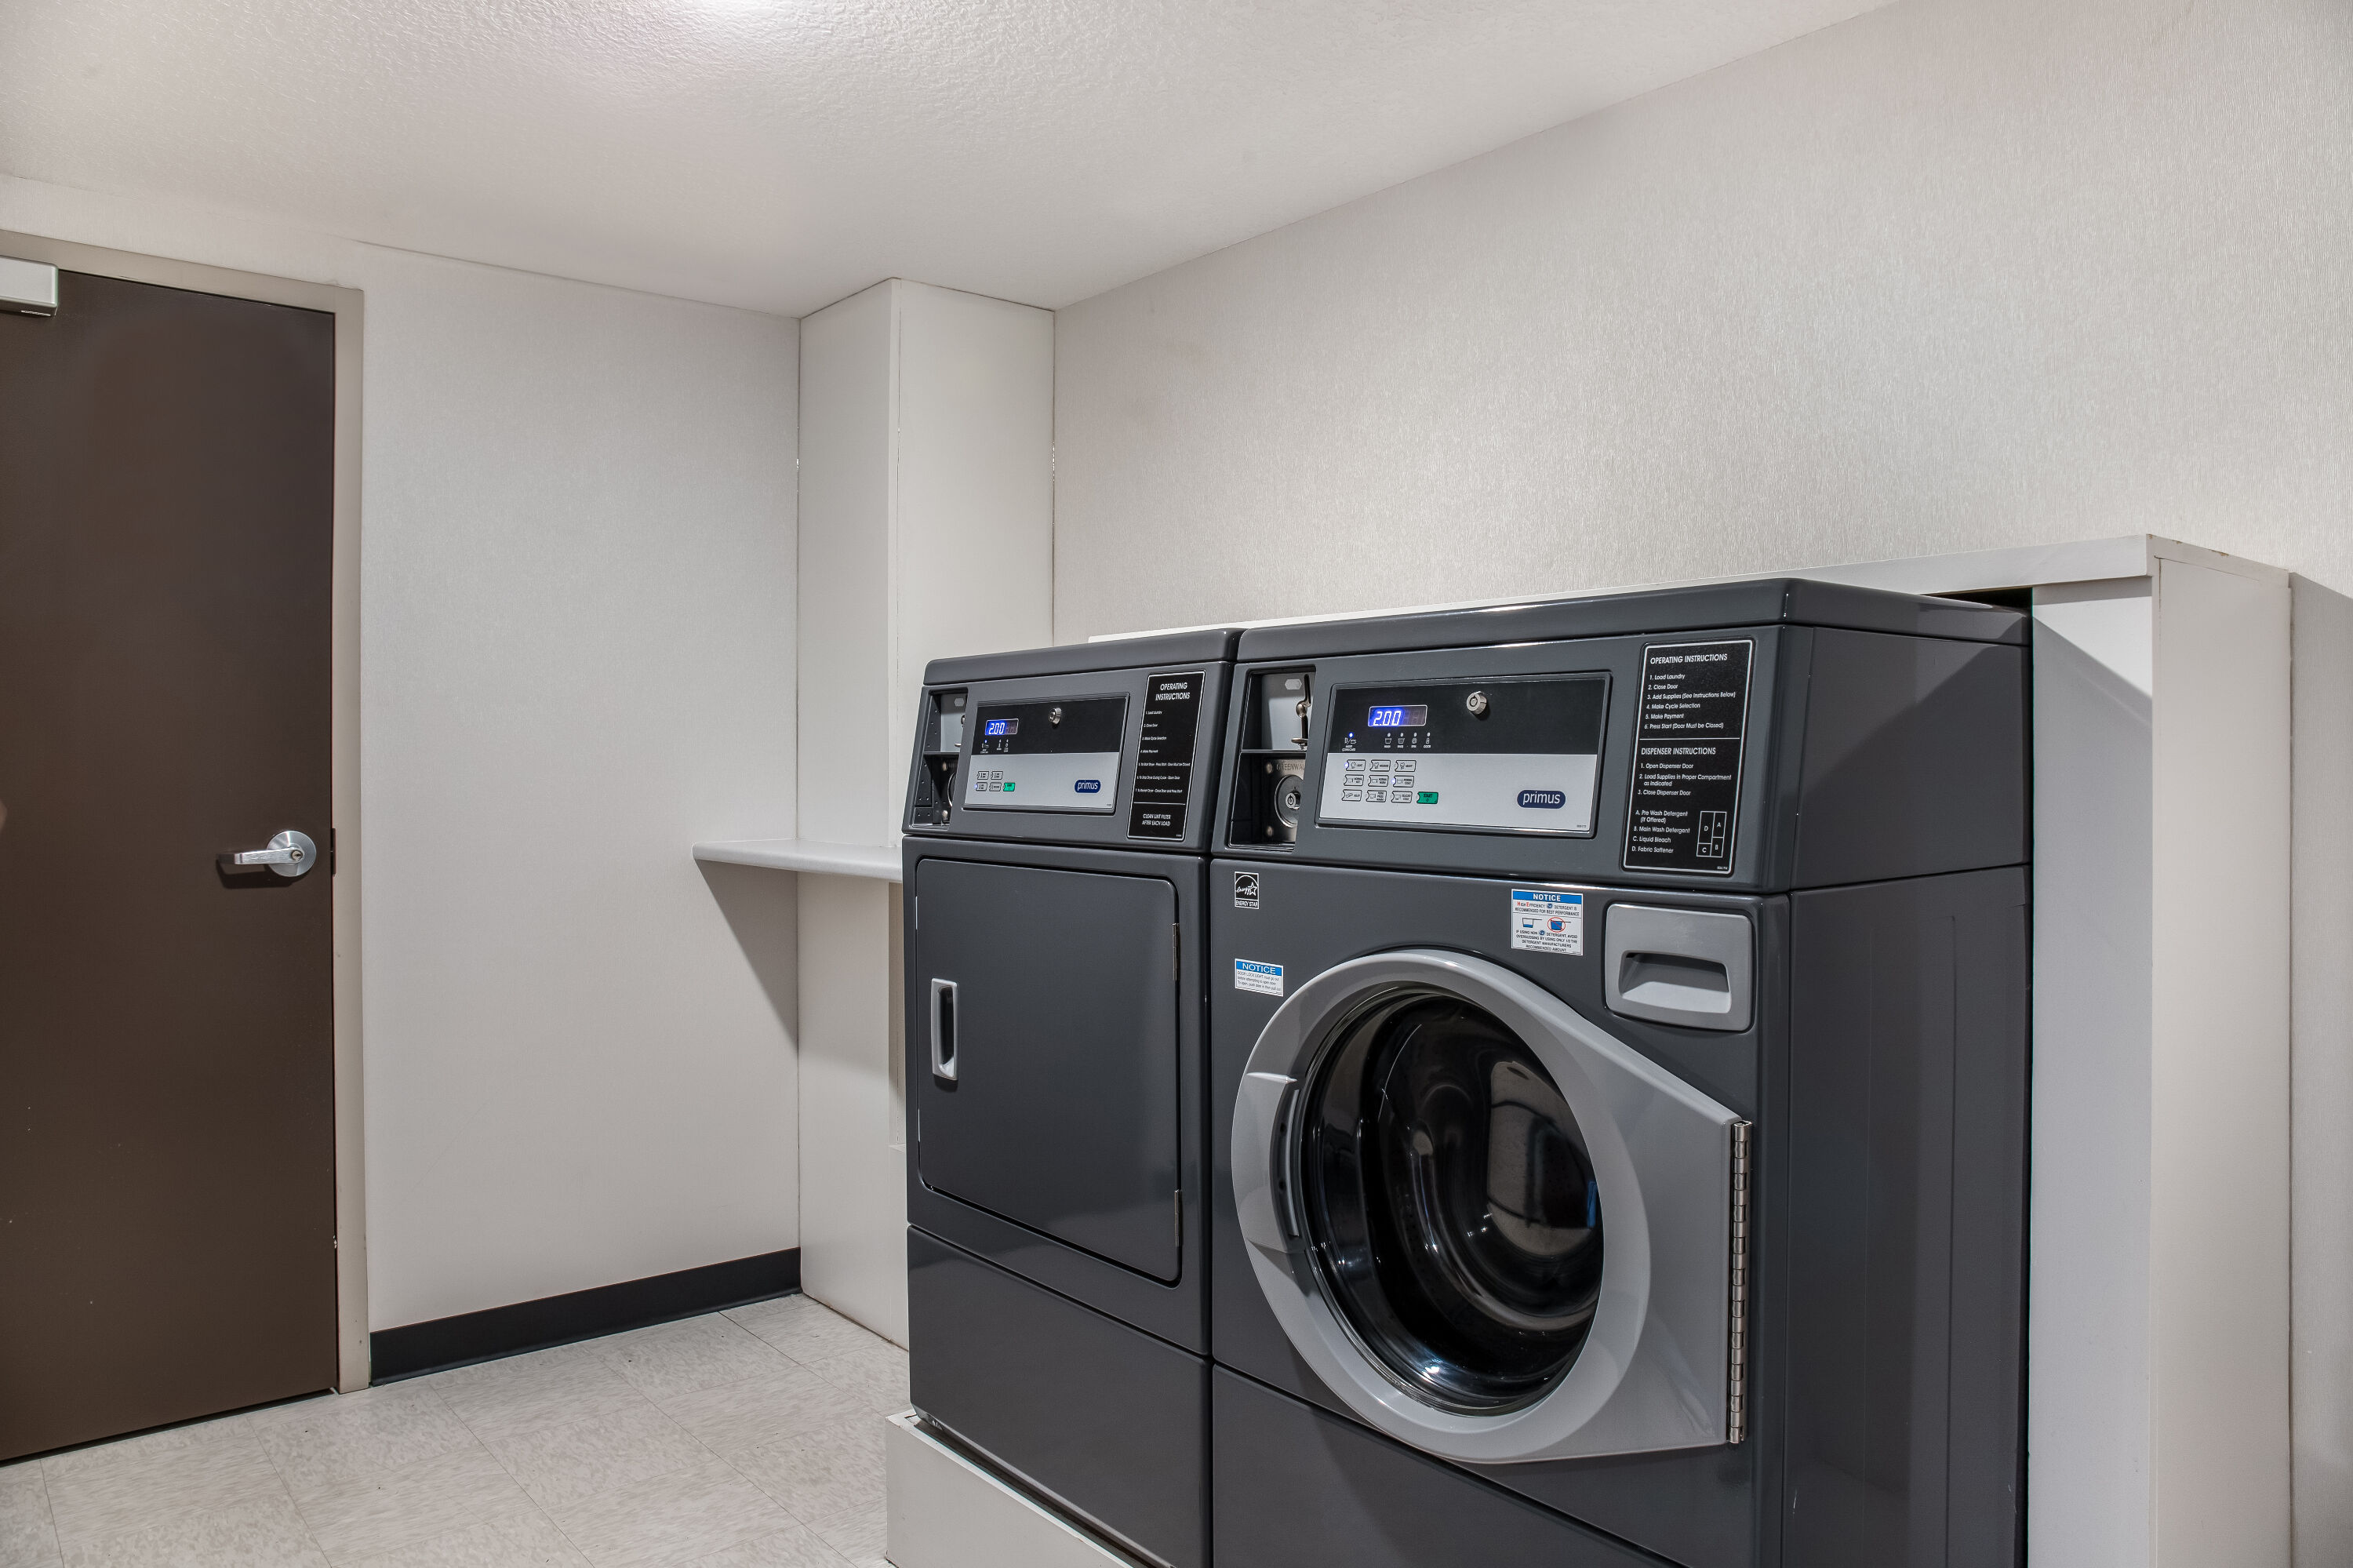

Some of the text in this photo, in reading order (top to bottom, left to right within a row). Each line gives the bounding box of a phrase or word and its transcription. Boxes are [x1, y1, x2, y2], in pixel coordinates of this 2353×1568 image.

[1650, 653, 1728, 664] OPERATING INSTRUCTIONS
[1160, 682, 1187, 690] OPERATING
[1155, 692, 1191, 701] INSTRUCTIONS
[1373, 711, 1402, 726] 2.00
[988, 722, 1006, 734] 2.00
[1077, 780, 1098, 791] primus
[1522, 791, 1561, 806] primus
[1533, 893, 1561, 901] NOTICE
[1242, 962, 1276, 974] NOTICE
